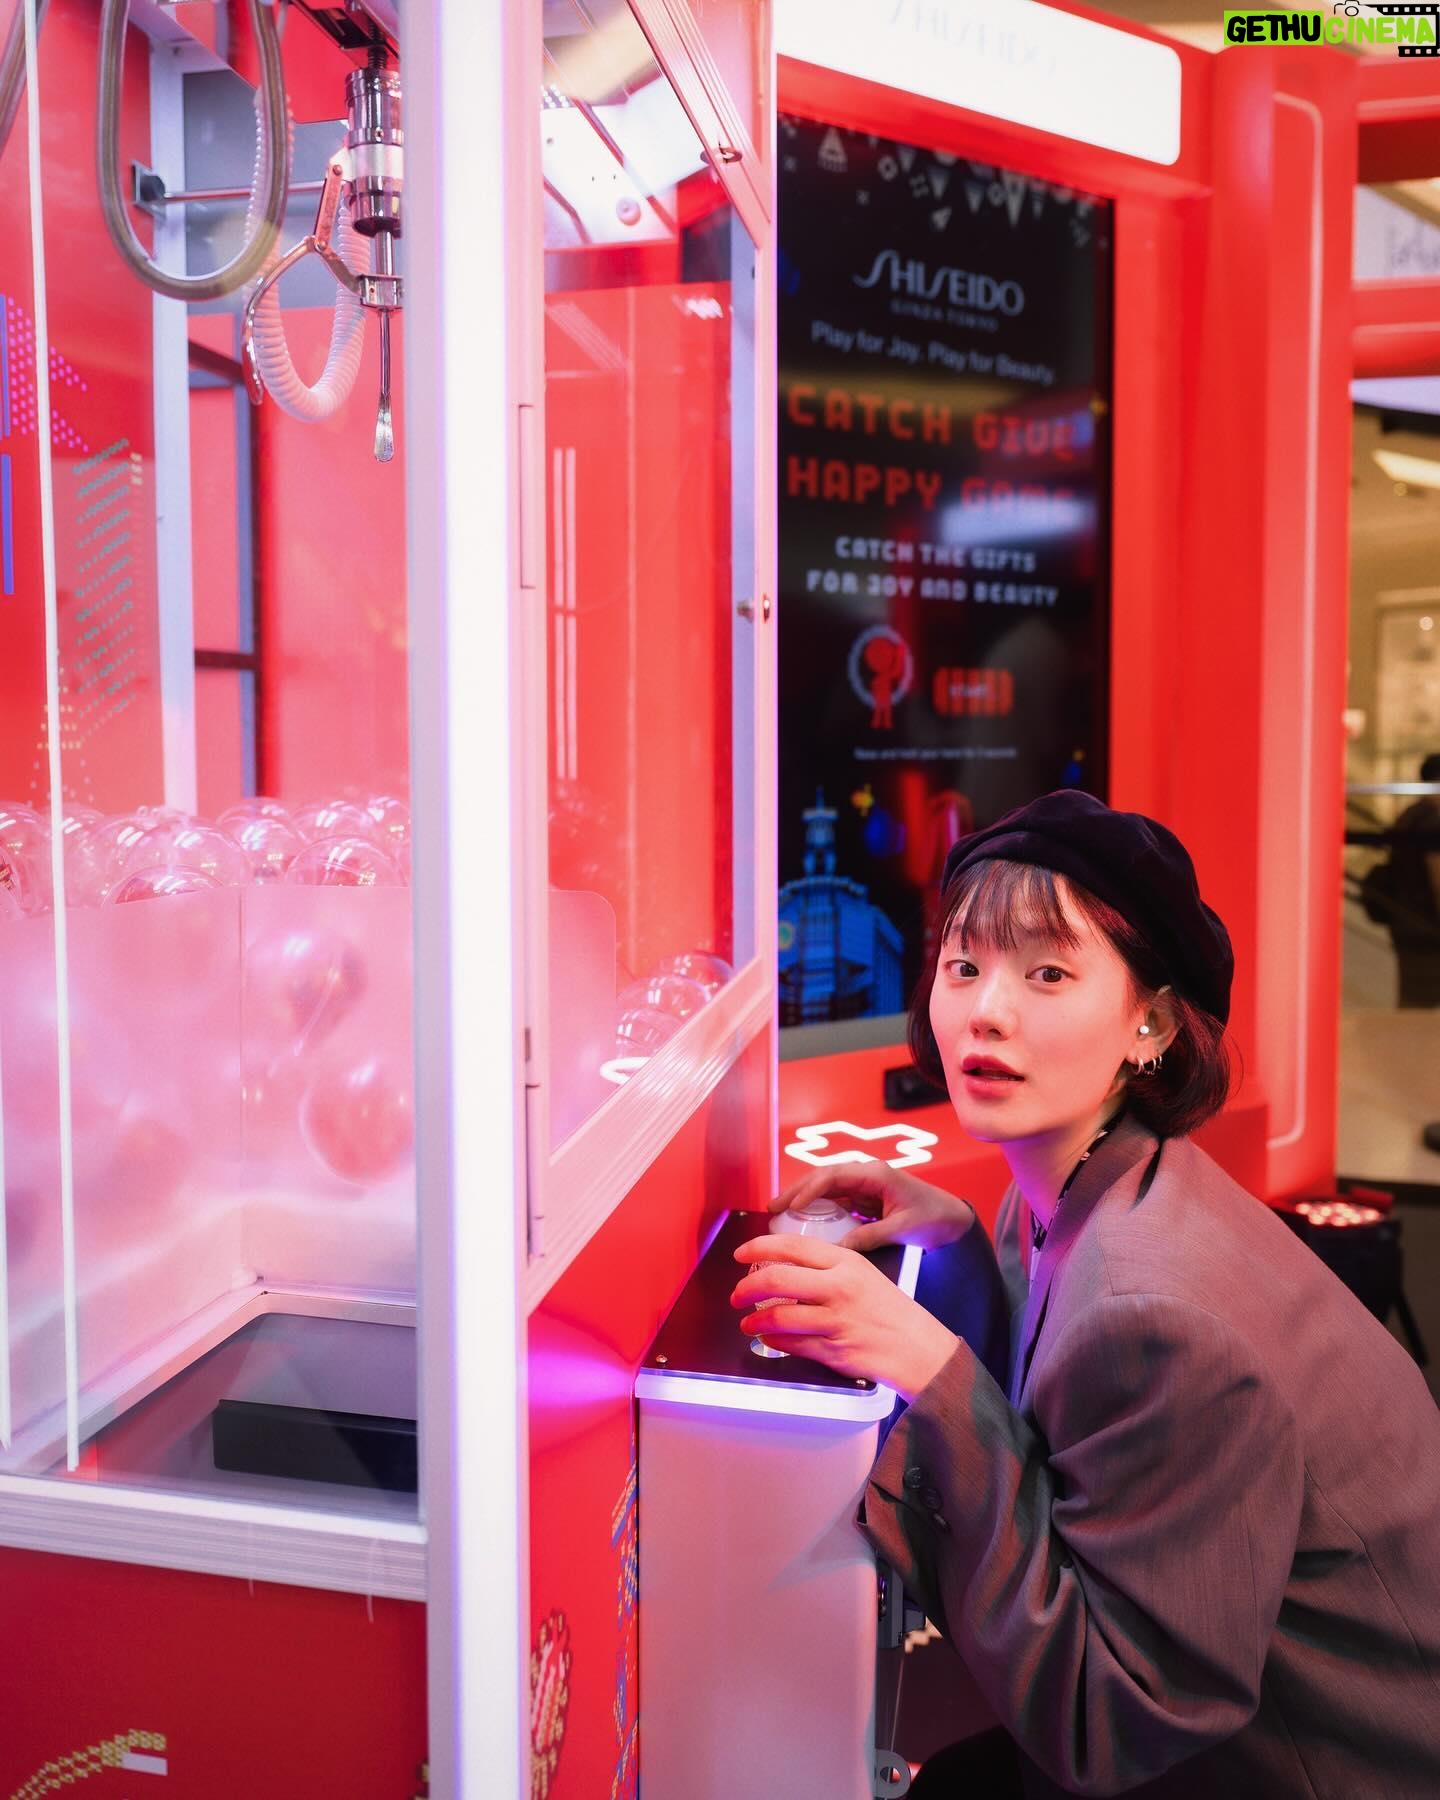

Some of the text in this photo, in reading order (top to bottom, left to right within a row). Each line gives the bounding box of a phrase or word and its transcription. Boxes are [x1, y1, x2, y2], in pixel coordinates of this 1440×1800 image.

[852, 248, 1025, 317] SHISEIDO
[811, 319, 852, 352] Play
[856, 328, 884, 353] for
[927, 340, 967, 371] Play
[968, 350, 993, 372] for
[995, 352, 1055, 386] Beauty
[786, 382, 952, 445] CATCH
[786, 455, 943, 511] HAPPY
[834, 535, 1038, 574] CATCH THE GIFTS
[805, 568, 860, 595] FOR
[918, 576, 968, 602] AND
[972, 580, 1060, 607] BEAUTY
